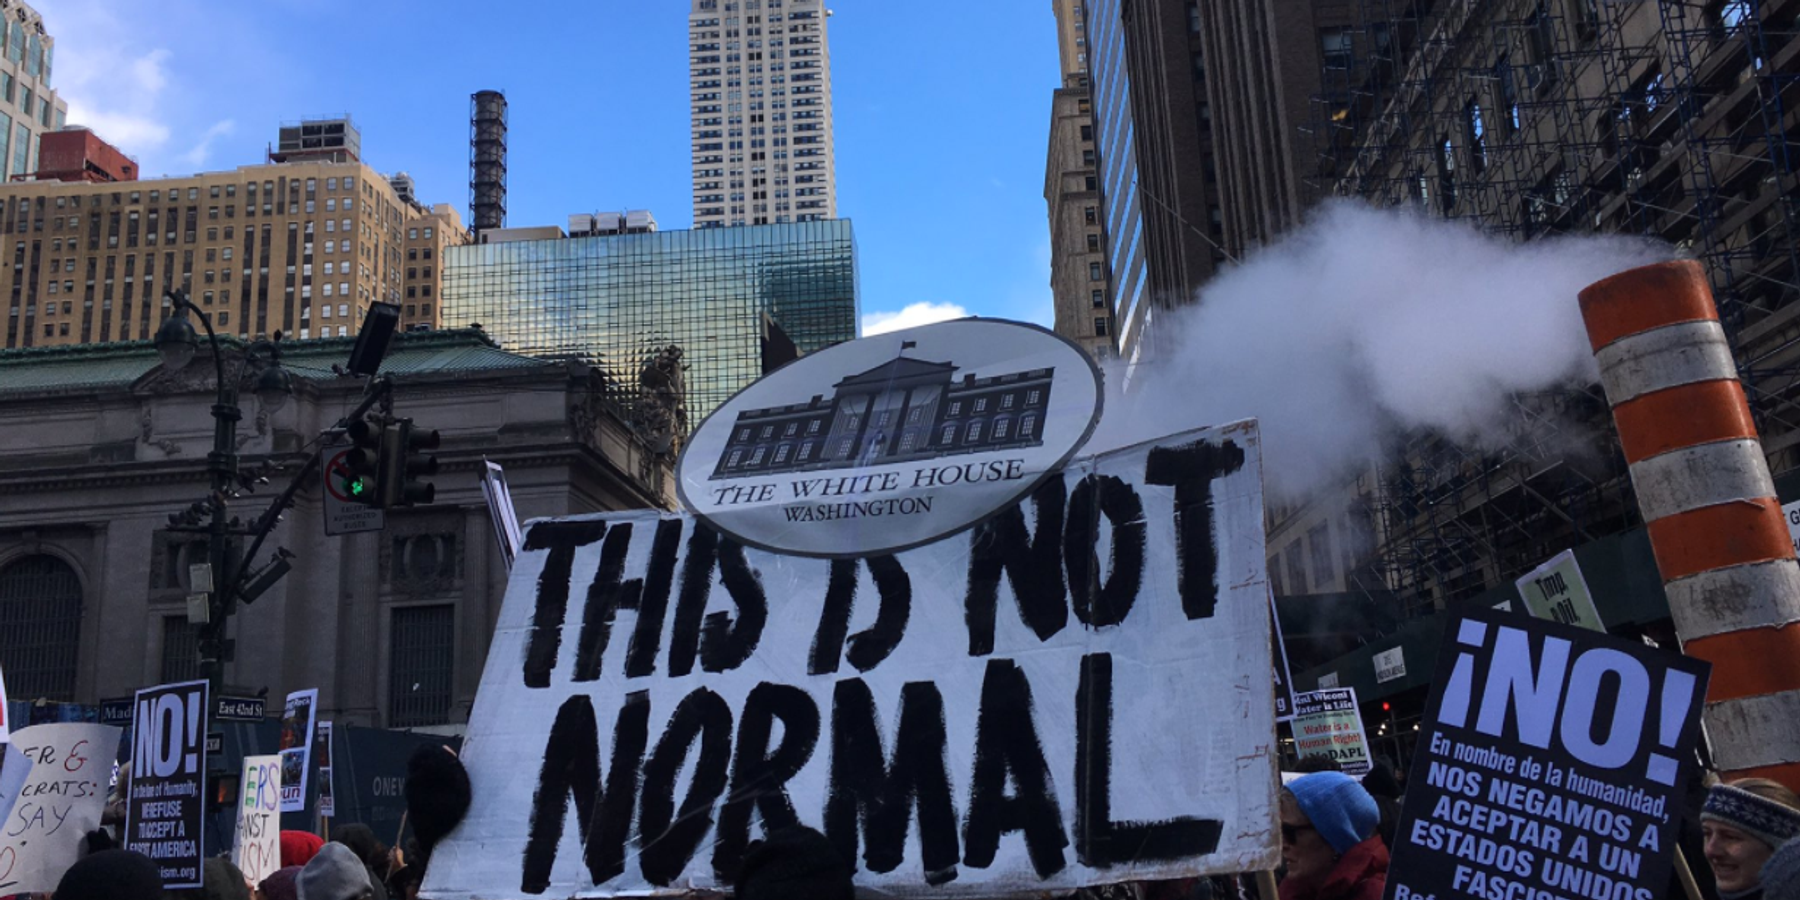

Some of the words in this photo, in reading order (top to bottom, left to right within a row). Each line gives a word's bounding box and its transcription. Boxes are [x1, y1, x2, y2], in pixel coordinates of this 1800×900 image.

[712, 483, 777, 505] THE
[790, 472, 900, 499] WHITE
[912, 459, 1025, 489] HOUSE
[784, 496, 933, 523] WASHINGTON
[522, 517, 768, 688] THIS
[964, 438, 1245, 657] NOT
[219, 701, 236, 715] East
[236, 703, 253, 716] 42nd
[254, 703, 262, 717] St
[1437, 617, 1697, 787] ¡NO!
[135, 691, 201, 778] NO!
[1304, 747, 1366, 761] NoDAPL
[22, 780, 97, 799] CRATS:
[245, 762, 280, 811] ERS
[521, 652, 1224, 894] NORMAL
[1430, 731, 1450, 755] En
[1453, 742, 1515, 774] nombre
[1519, 756, 1542, 781] de
[1545, 762, 1561, 787] la
[1566, 772, 1670, 824] humanidad,
[8, 803, 72, 837] SAY
[177, 820, 185, 837] A
[1426, 761, 1482, 798] NOS
[1488, 778, 1633, 842] NEGAMOS
[1638, 824, 1660, 852] A
[150, 839, 197, 858] AMERICA
[1410, 818, 1534, 878] ESTADOS
[1432, 795, 1562, 854] ACEPTAR
[1568, 835, 1589, 864] A
[1599, 843, 1641, 879] UN
[160, 865, 196, 879] ism.org
